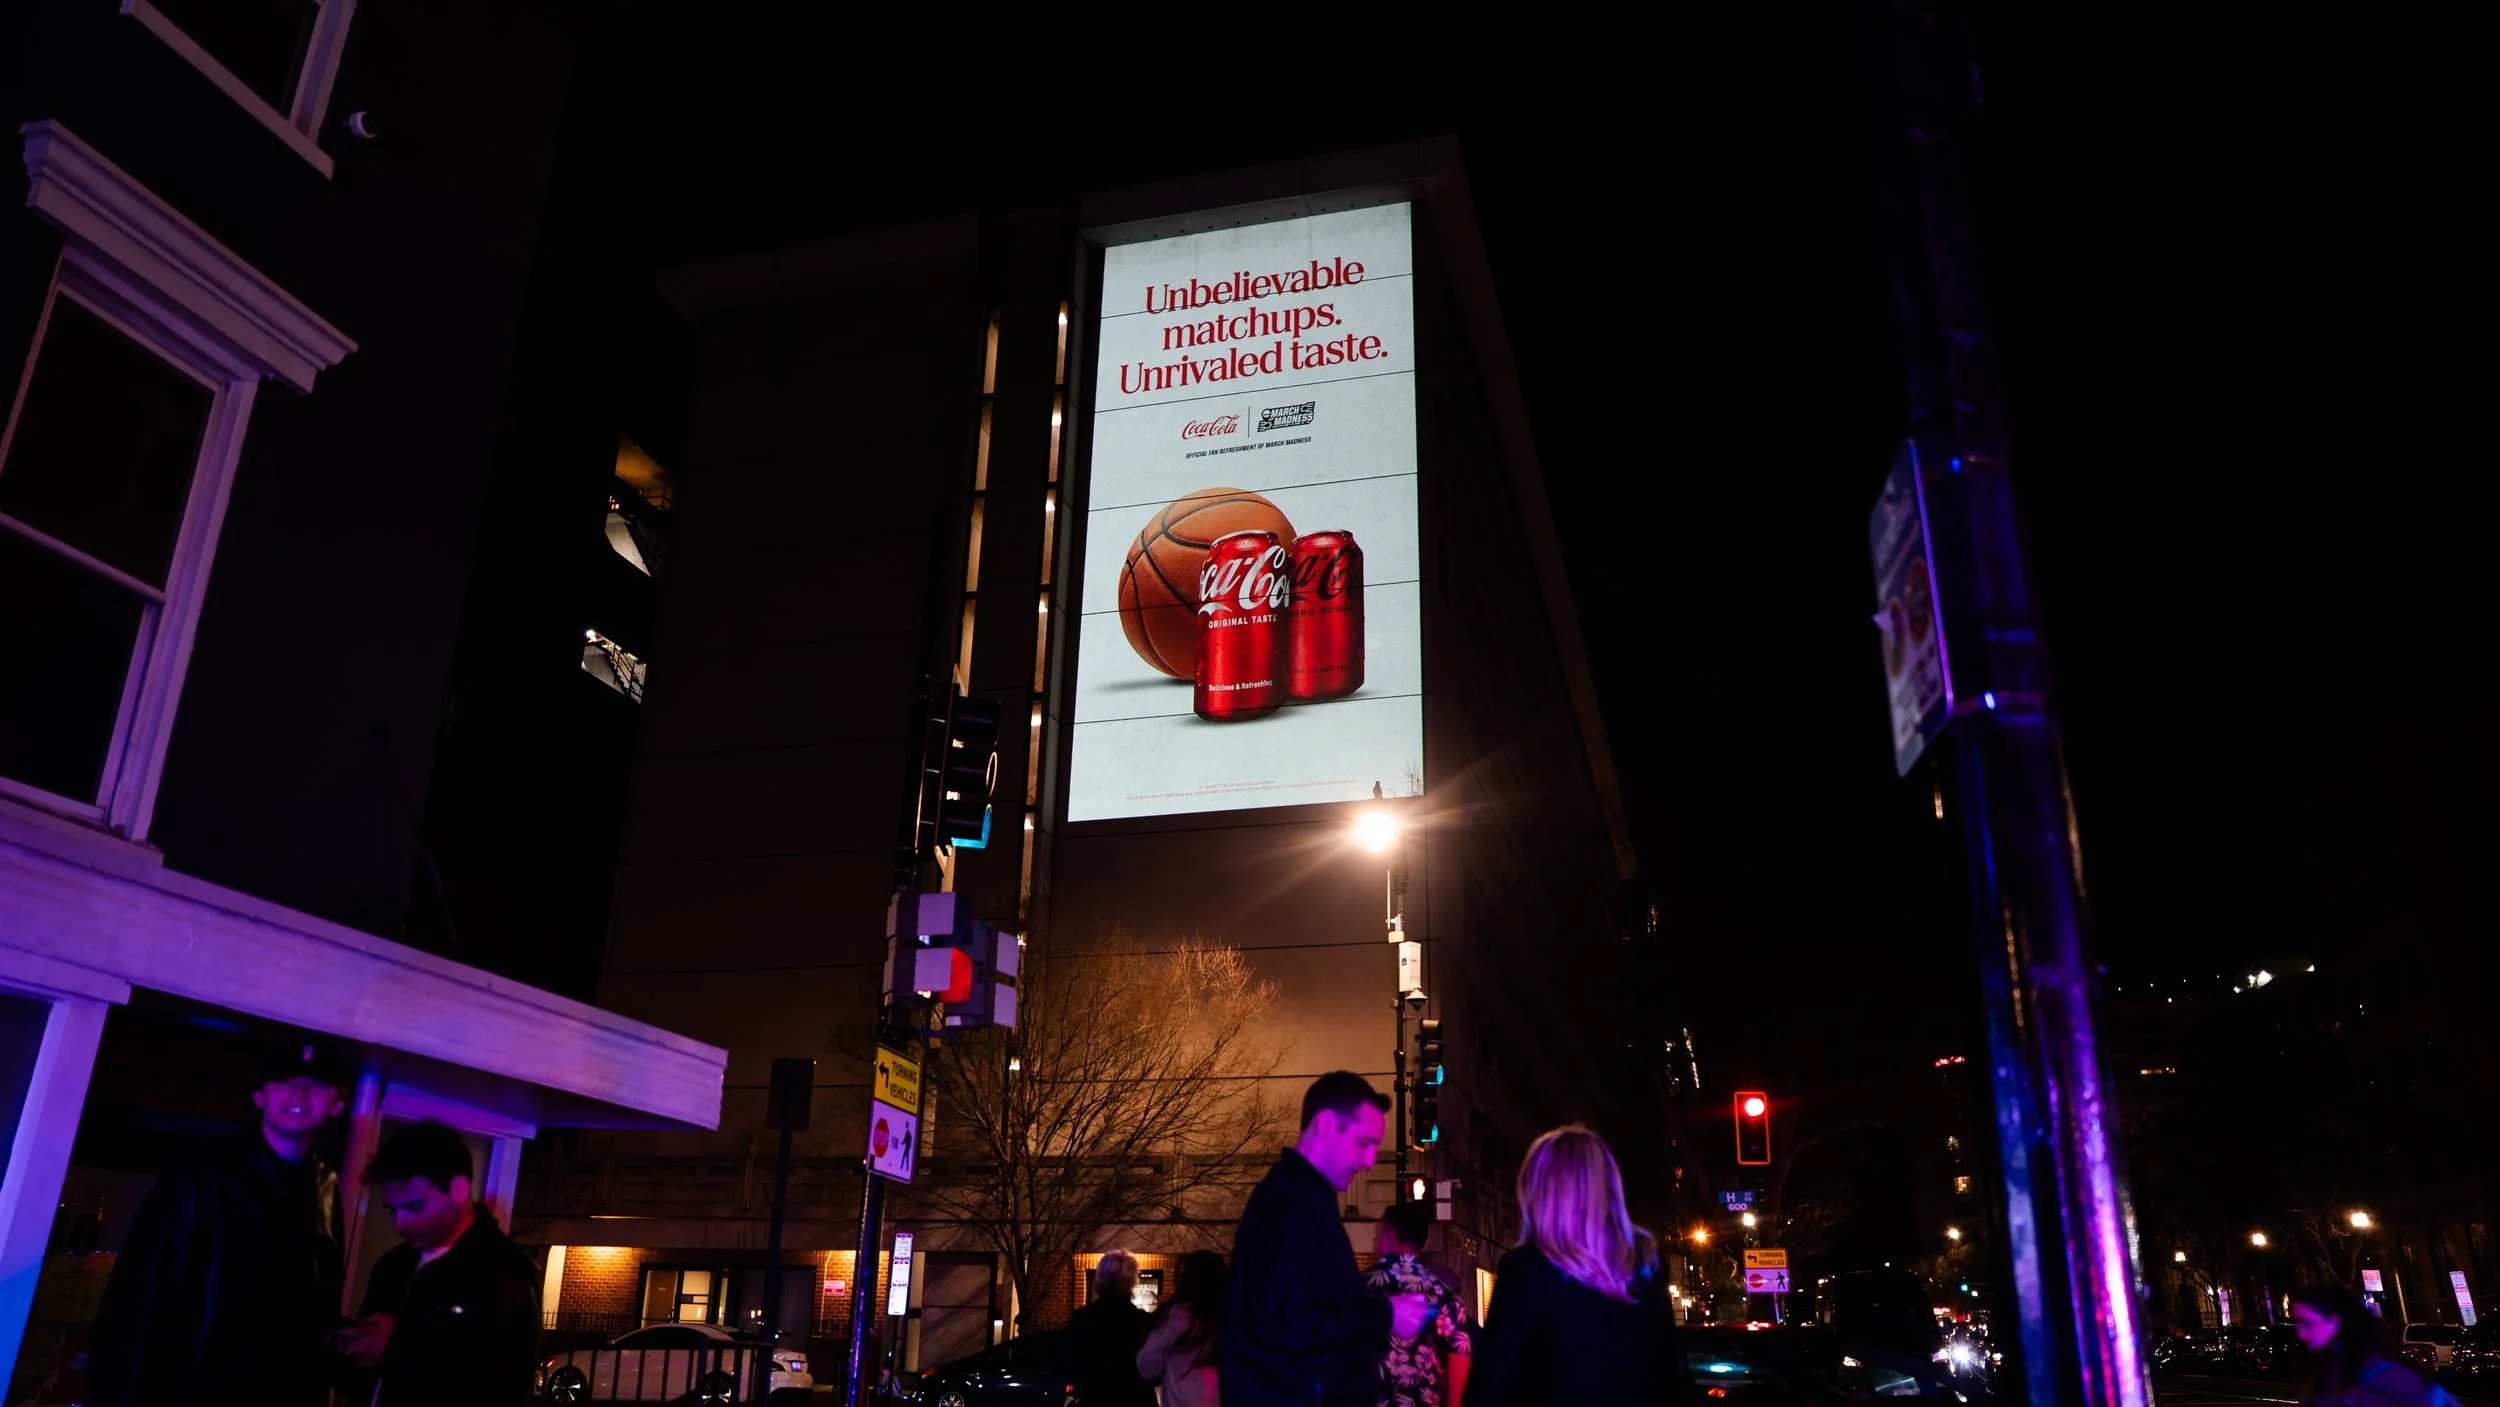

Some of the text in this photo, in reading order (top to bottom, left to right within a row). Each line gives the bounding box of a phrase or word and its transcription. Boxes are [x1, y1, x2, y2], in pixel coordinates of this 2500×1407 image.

[1146, 257, 1364, 314] Unbelievable
[1163, 303, 1342, 350] matchups.
[1120, 334, 1388, 394] Unrivaled taste.
[1270, 405, 1300, 418] MARCH
[1273, 412, 1314, 426] MADNESS
[1182, 414, 1240, 440] Coca-Cola
[1186, 451, 1207, 459] OFFICIAL
[1220, 443, 1257, 454] REFRESHMENT
[1265, 440, 1285, 448] MARCH
[1285, 436, 1312, 446] MADNESS
[1208, 614, 1278, 629] ORIGINAL TASTE
[1209, 684, 1234, 692] Delicious
[1241, 679, 1273, 690] Refreshing
[891, 1061, 917, 1085] TURNING
[889, 1082, 917, 1106] VEHICLES
[1726, 1192, 1735, 1202] H
[1728, 1203, 1748, 1211] 600
